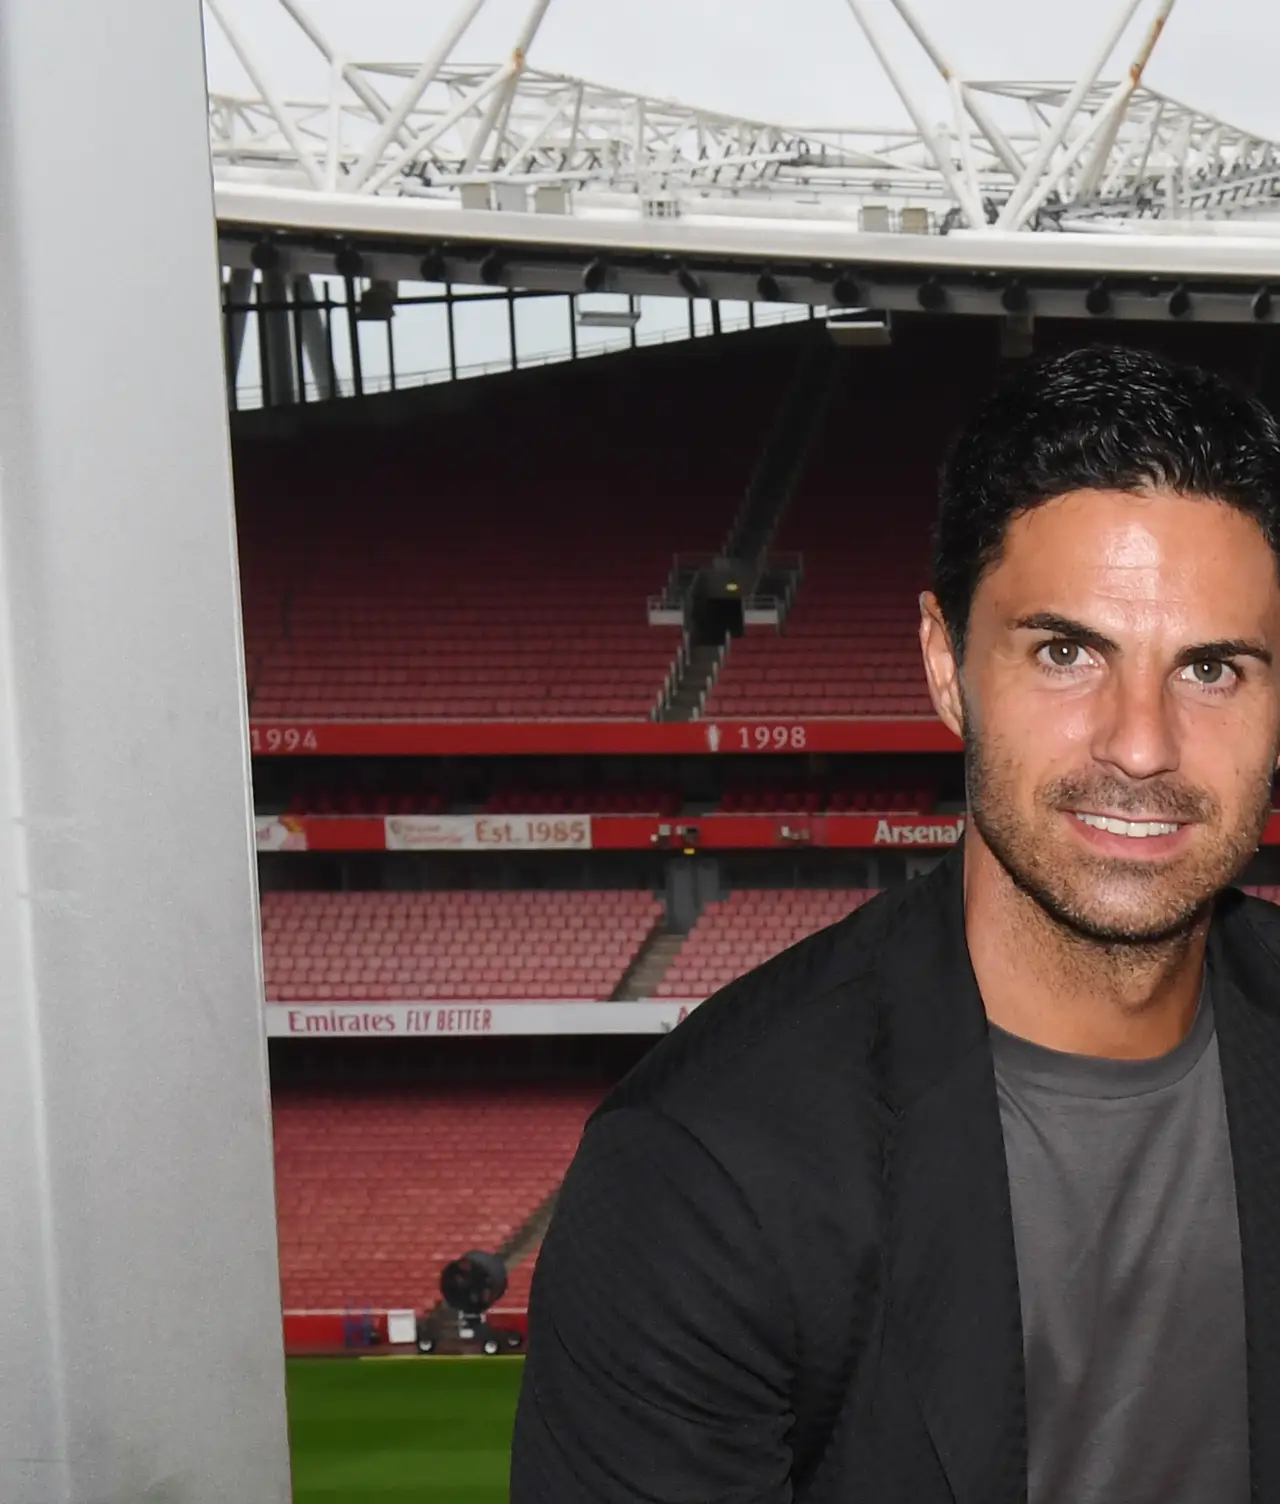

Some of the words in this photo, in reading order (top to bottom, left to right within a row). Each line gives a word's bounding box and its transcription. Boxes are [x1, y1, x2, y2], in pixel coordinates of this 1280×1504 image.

[252, 729, 318, 751] 1994
[739, 726, 806, 749] 1998
[527, 821, 587, 843] 1985
[287, 1009, 396, 1033] Emirates
[405, 1009, 432, 1032] FLY
[436, 1008, 492, 1032] BETTER
